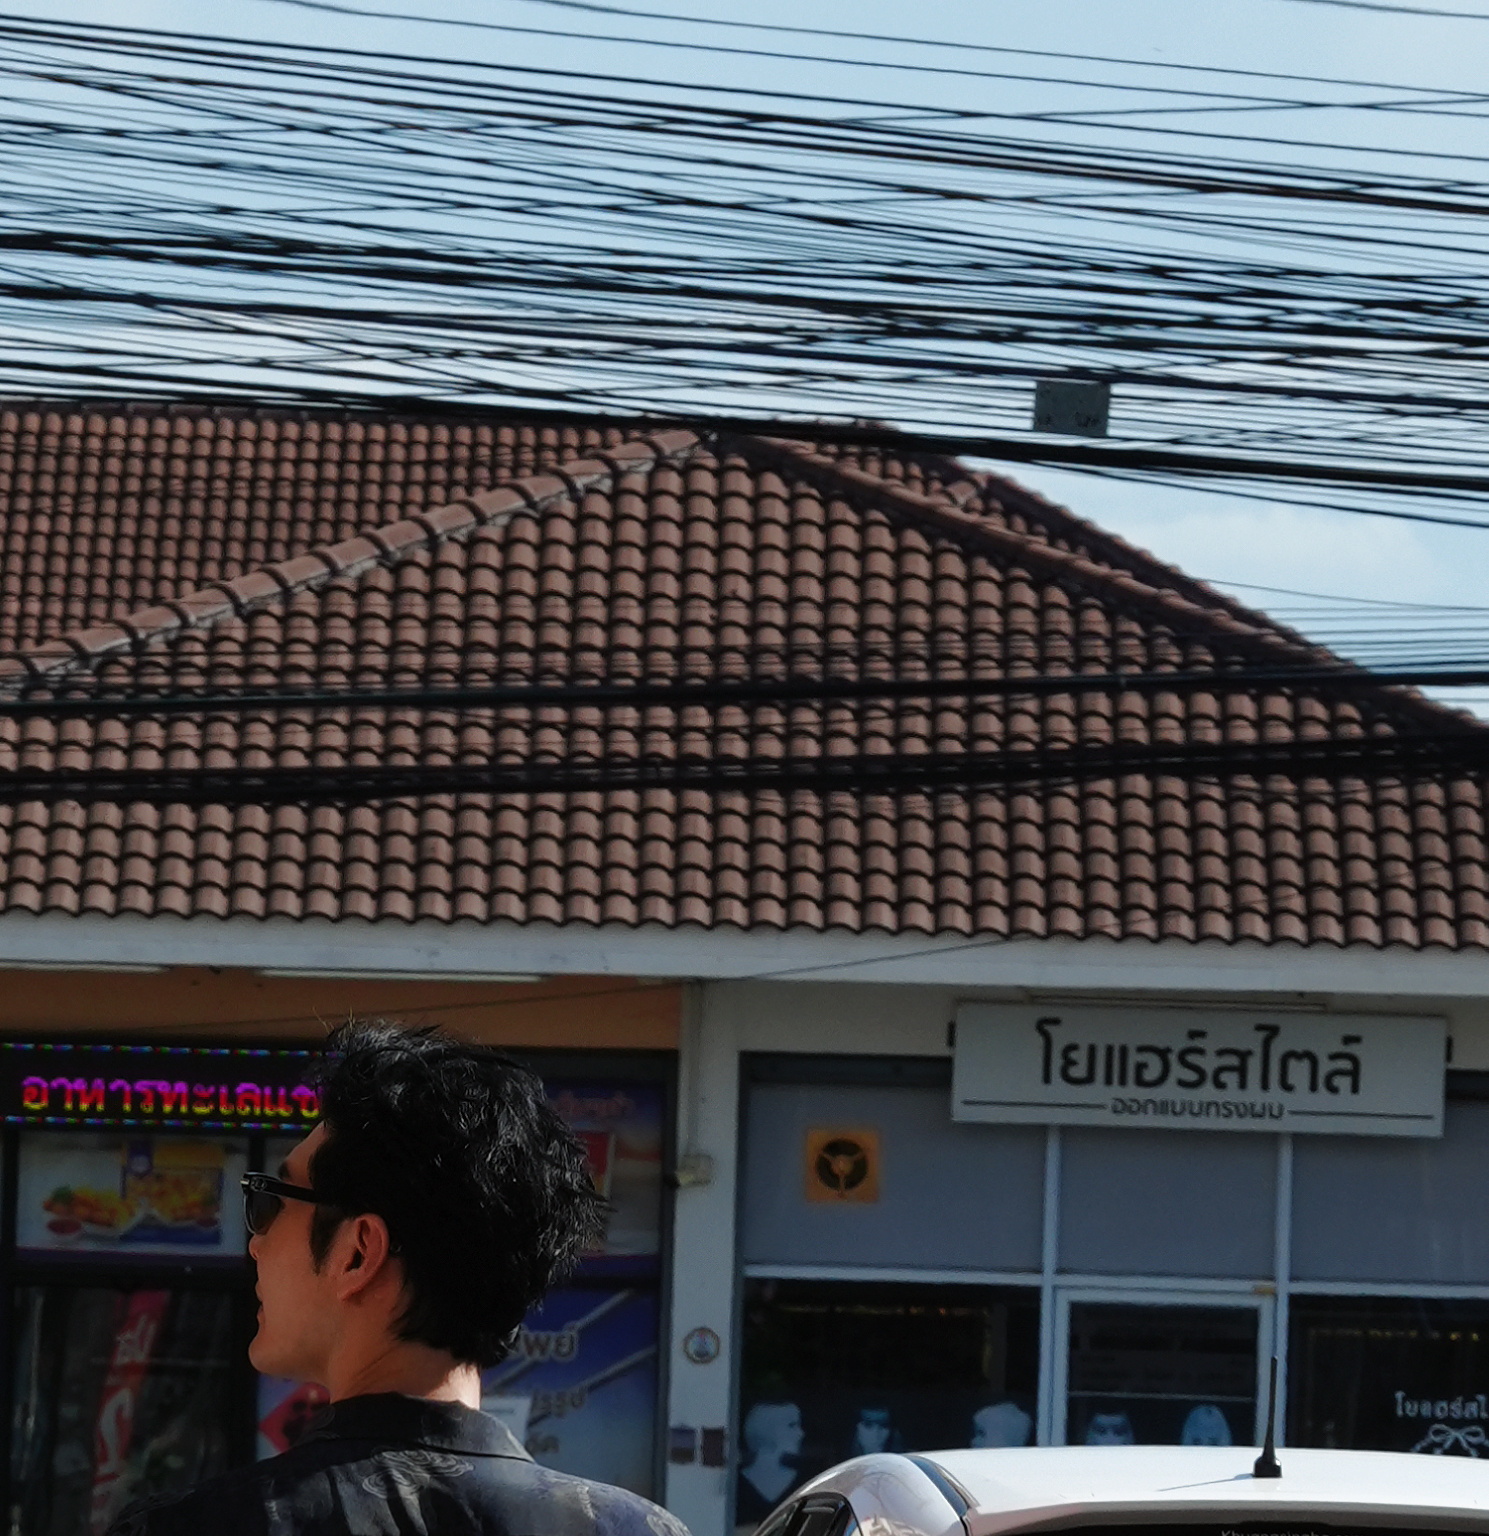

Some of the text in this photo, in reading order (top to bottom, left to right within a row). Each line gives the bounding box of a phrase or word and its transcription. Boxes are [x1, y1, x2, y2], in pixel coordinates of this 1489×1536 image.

[1035, 1017, 1363, 1096] โยแฮร์สไตล์
